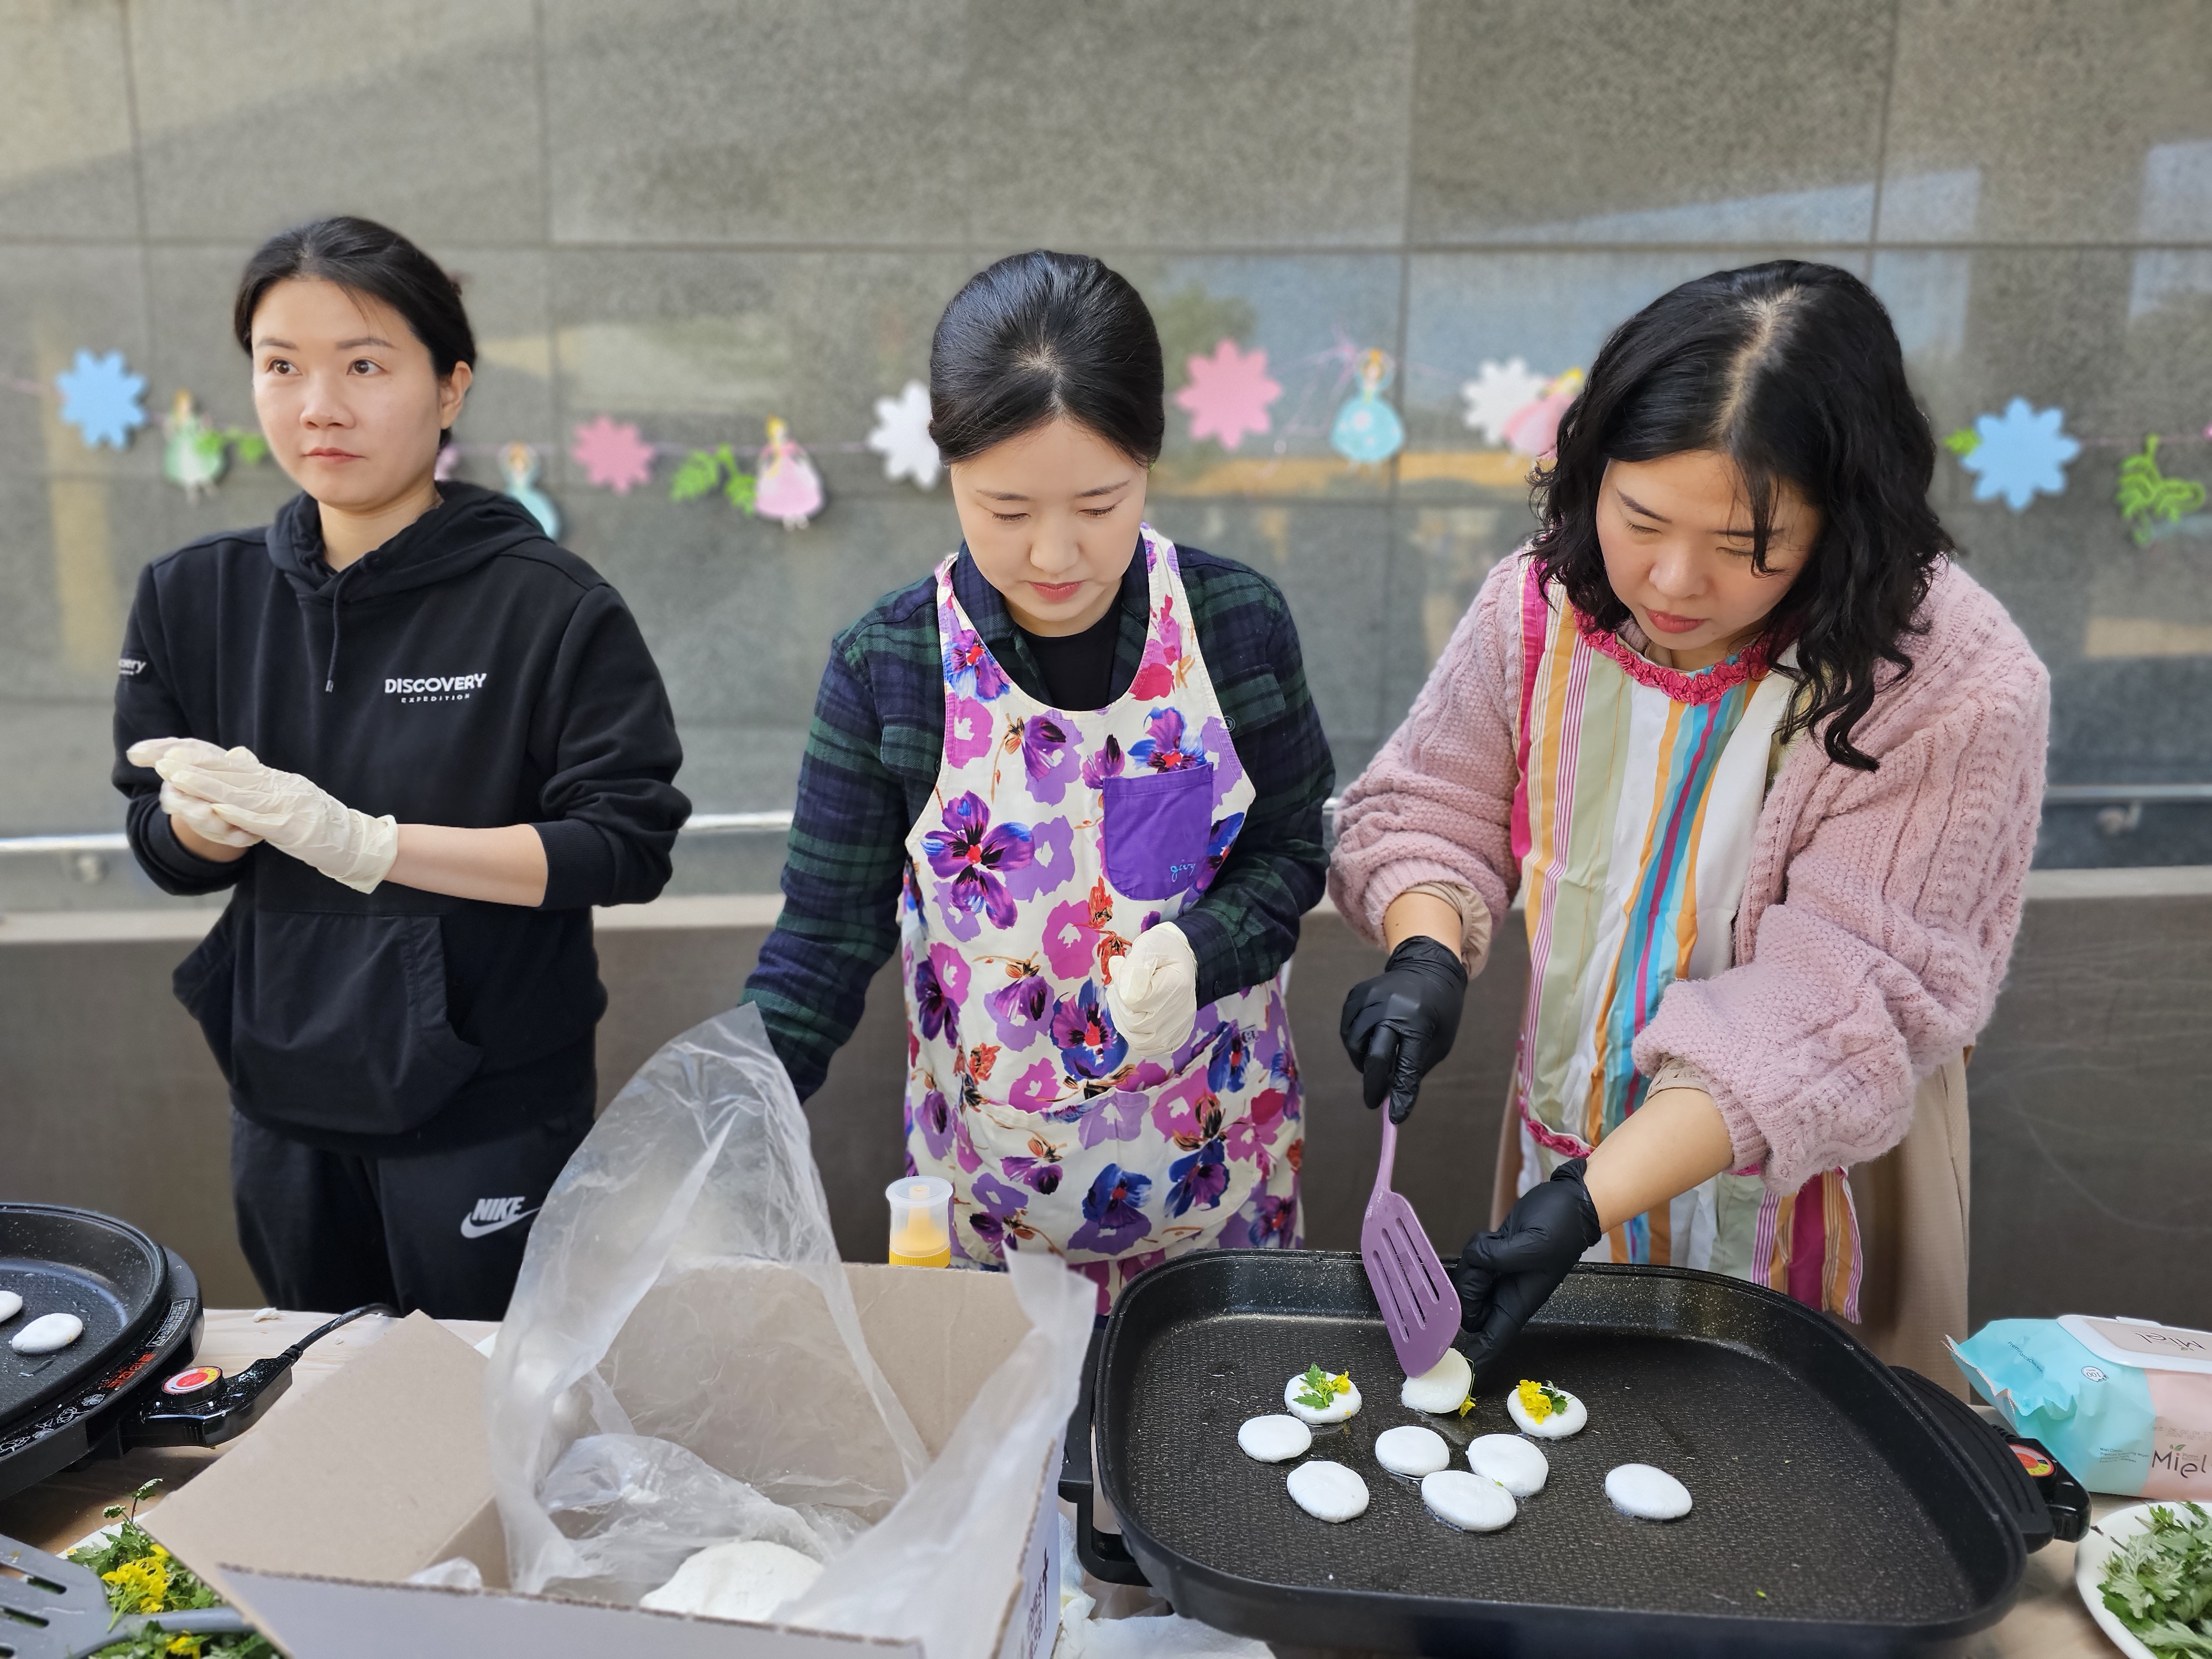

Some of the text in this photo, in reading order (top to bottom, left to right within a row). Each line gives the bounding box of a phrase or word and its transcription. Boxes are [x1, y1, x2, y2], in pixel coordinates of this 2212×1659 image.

[385, 673, 487, 693] DISCOVERY
[401, 693, 471, 703] EXPEDITION
[471, 1196, 526, 1221] NIKE
[2135, 1333, 2206, 1350] Miel
[2152, 1449, 2207, 1479] Miel
